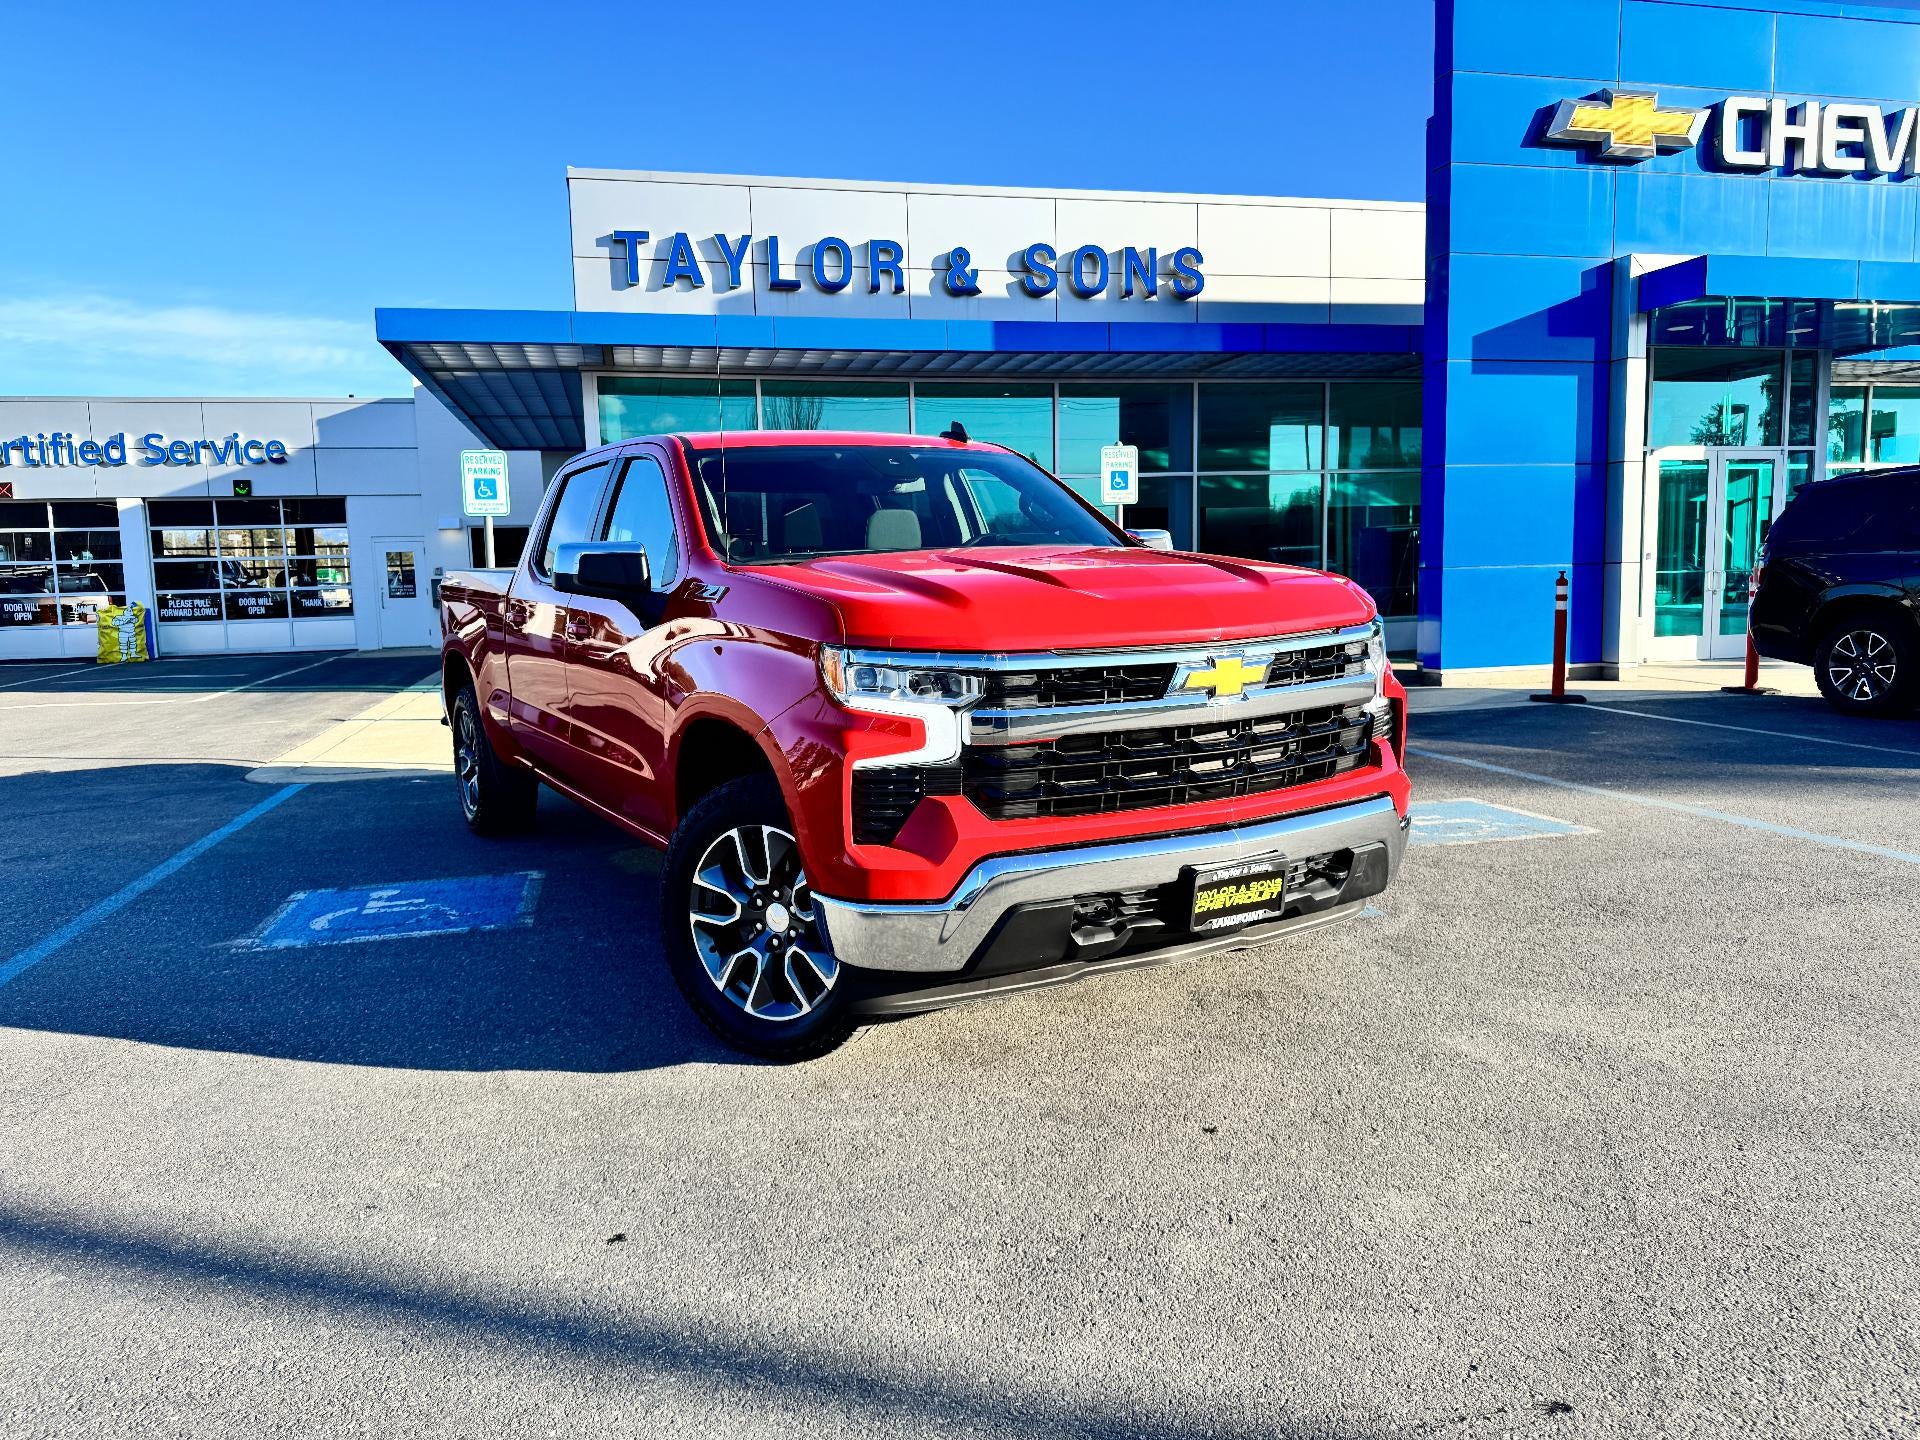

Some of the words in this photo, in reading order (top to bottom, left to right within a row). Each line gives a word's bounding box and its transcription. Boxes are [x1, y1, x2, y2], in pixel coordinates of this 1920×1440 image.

[1722, 95, 1920, 173] CHEV
[612, 229, 905, 294] TAYLOR
[944, 246, 982, 296] &
[1023, 242, 1205, 299] SONS
[143, 432, 287, 466] Service
[1104, 451, 1134, 459] RESERVED
[464, 455, 503, 465] RESERVED
[1105, 461, 1133, 469] PARKING
[467, 467, 501, 476] PARKING
[168, 600, 193, 608] PLEASE
[194, 599, 210, 608] PULL
[239, 598, 256, 606] DOOR
[257, 597, 273, 606] WILL
[301, 599, 322, 607] THANK
[4, 603, 23, 612] DOOR
[25, 603, 41, 612] WILL
[160, 608, 192, 617] FORWARD
[193, 607, 219, 616] SLOWLY
[247, 607, 265, 615] OPEN
[14, 612, 33, 621] OPEN
[1217, 868, 1242, 880] Taylor
[1196, 885, 1237, 902] TAYLOR
[1239, 884, 1247, 894] &
[1250, 878, 1283, 893] SONS
[1195, 890, 1281, 913] CHEVROLET
[1212, 910, 1265, 929] SANDPOINT
